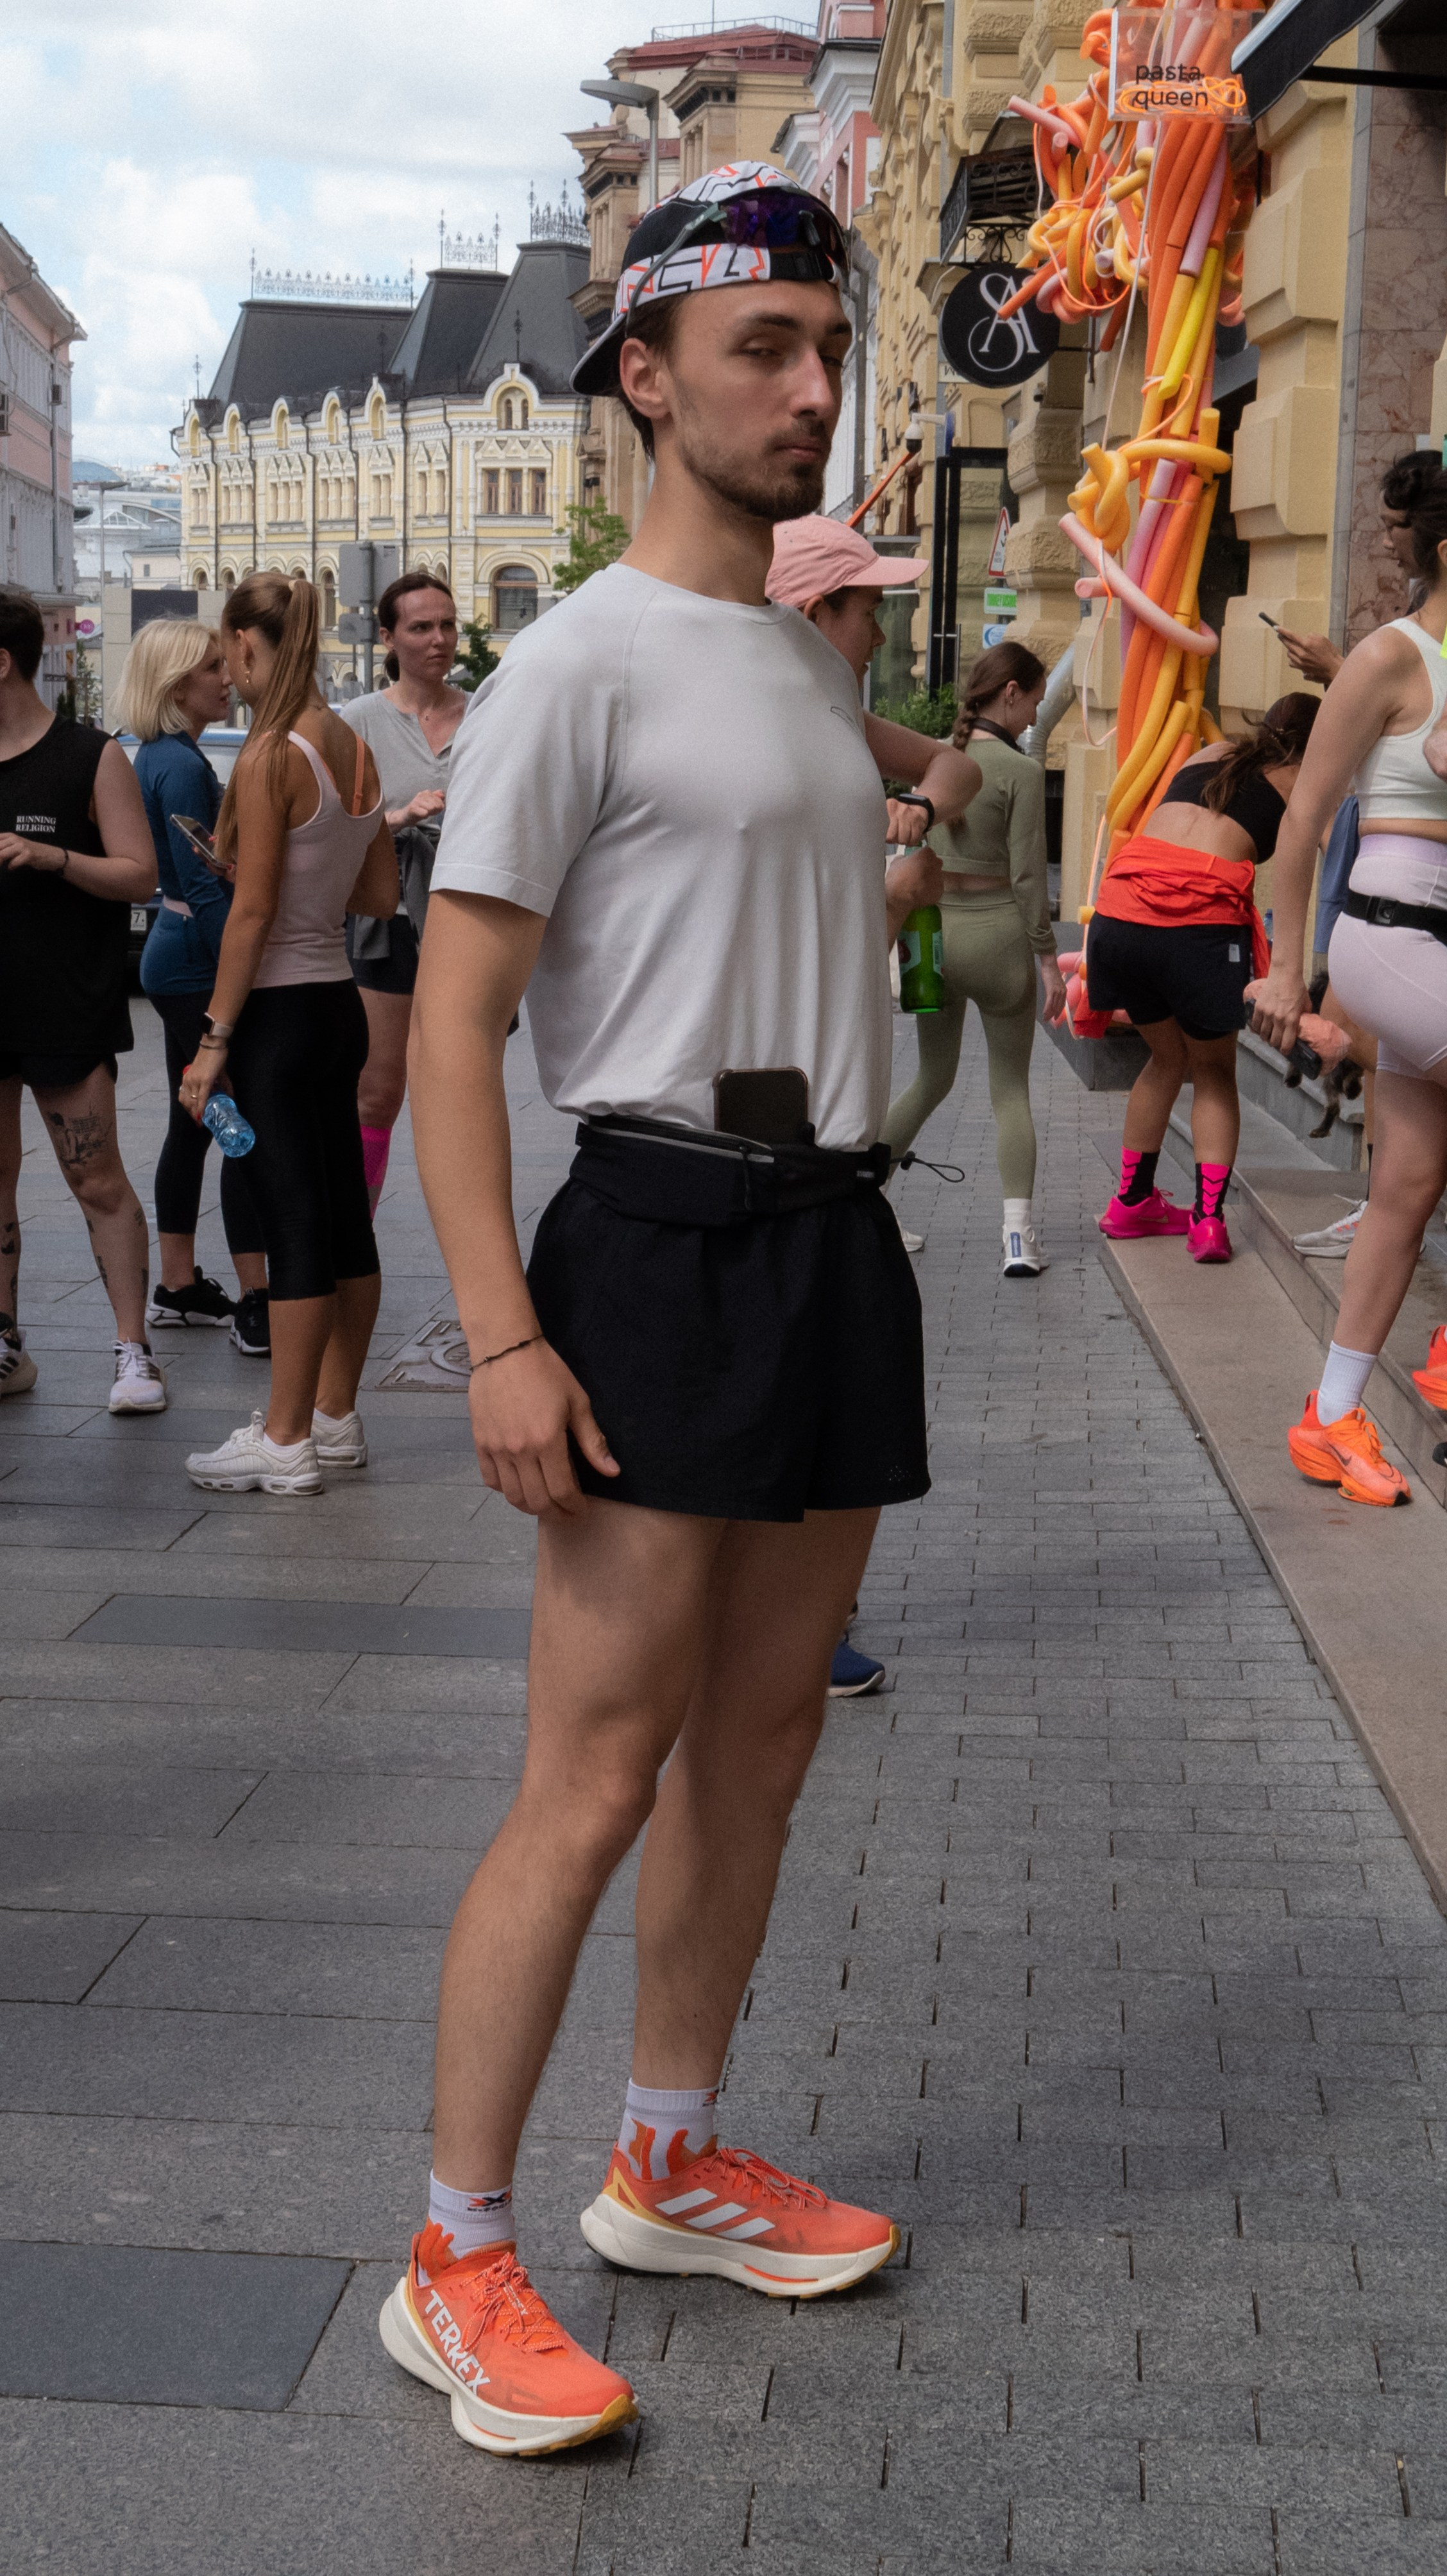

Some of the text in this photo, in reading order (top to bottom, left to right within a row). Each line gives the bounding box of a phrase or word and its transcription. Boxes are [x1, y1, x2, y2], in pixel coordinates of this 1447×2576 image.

[1136, 63, 1201, 85] pasta
[1135, 90, 1208, 110] queen
[16, 815, 56, 825] RUNNING
[15, 824, 56, 833] RELIGION
